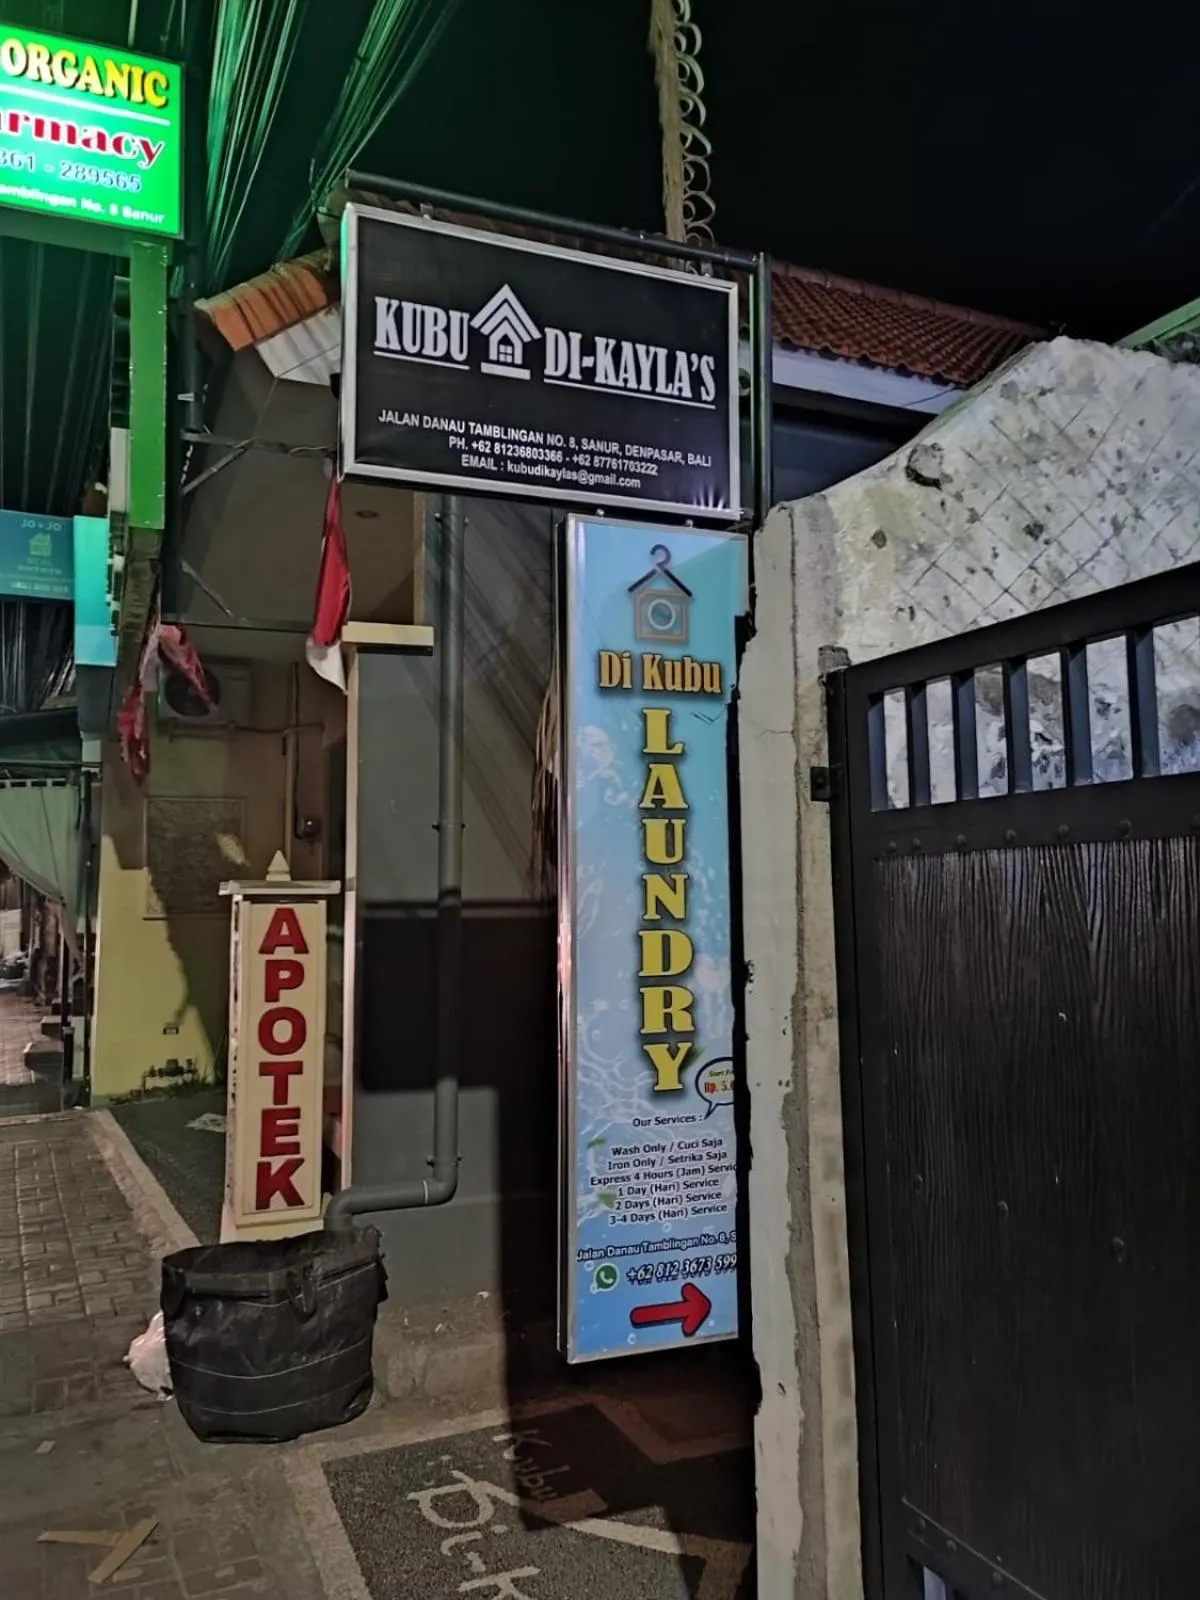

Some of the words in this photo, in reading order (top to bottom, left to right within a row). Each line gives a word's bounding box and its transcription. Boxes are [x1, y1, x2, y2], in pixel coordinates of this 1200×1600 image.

[1, 38, 170, 109] ORGANIC
[0, 109, 164, 168] rmacy
[60, 160, 142, 193] 289565
[374, 296, 470, 362] KUBU
[543, 326, 716, 402] DI-KAYLA'S
[378, 409, 420, 427] JALAN
[422, 415, 465, 434] DANAU
[468, 422, 544, 445] TAMBLINGAN
[546, 433, 567, 448] NO.
[569, 436, 579, 451] 8,
[581, 438, 622, 456] SANUR,
[625, 444, 685, 465] DENPASAR,
[687, 453, 713, 468] BALI
[449, 436, 469, 450] PH.
[471, 440, 491, 454] +62
[494, 443, 563, 463] 81236803366
[572, 453, 591, 467] +62
[461, 454, 498, 471] EMAIL
[507, 460, 641, 489] kubudikaylas@gmail.com
[598, 650, 632, 690] Di
[642, 652, 722, 695] Kubu
[638, 708, 695, 1092] LAUNDRY
[255, 907, 309, 1211] APOTEK
[632, 1118, 651, 1128] Our
[655, 1114, 696, 1126] Services
[608, 1160, 630, 1171] Iron
[633, 1158, 657, 1170] Only
[668, 1153, 703, 1165] Setrika
[706, 1150, 727, 1162] Saja
[612, 1145, 640, 1156] Wash
[643, 1143, 667, 1155] Only
[677, 1140, 699, 1150] Cuci
[702, 1137, 723, 1149] Saja
[590, 1175, 631, 1187] Express
[634, 1173, 640, 1181] 4
[643, 1170, 674, 1181] Hours
[676, 1166, 705, 1178] (Jam)
[618, 1188, 623, 1197] 1
[627, 1186, 647, 1197] Day
[650, 1182, 680, 1195] (Hari)
[683, 1179, 719, 1190] Service
[609, 1214, 627, 1225] 3-4
[630, 1211, 656, 1224] Days
[658, 1208, 688, 1221] (Hari)
[691, 1204, 728, 1216] Service
[616, 1202, 621, 1211] 2
[625, 1199, 650, 1210] Days
[653, 1195, 683, 1208] (Hari)
[686, 1191, 722, 1203] Service
[577, 1249, 605, 1262] Jalan
[607, 1245, 641, 1258] Danau
[642, 1237, 699, 1252] Tamblingan
[700, 1233, 717, 1245] No.
[627, 1263, 654, 1281] +62
[656, 1259, 681, 1277] 812
